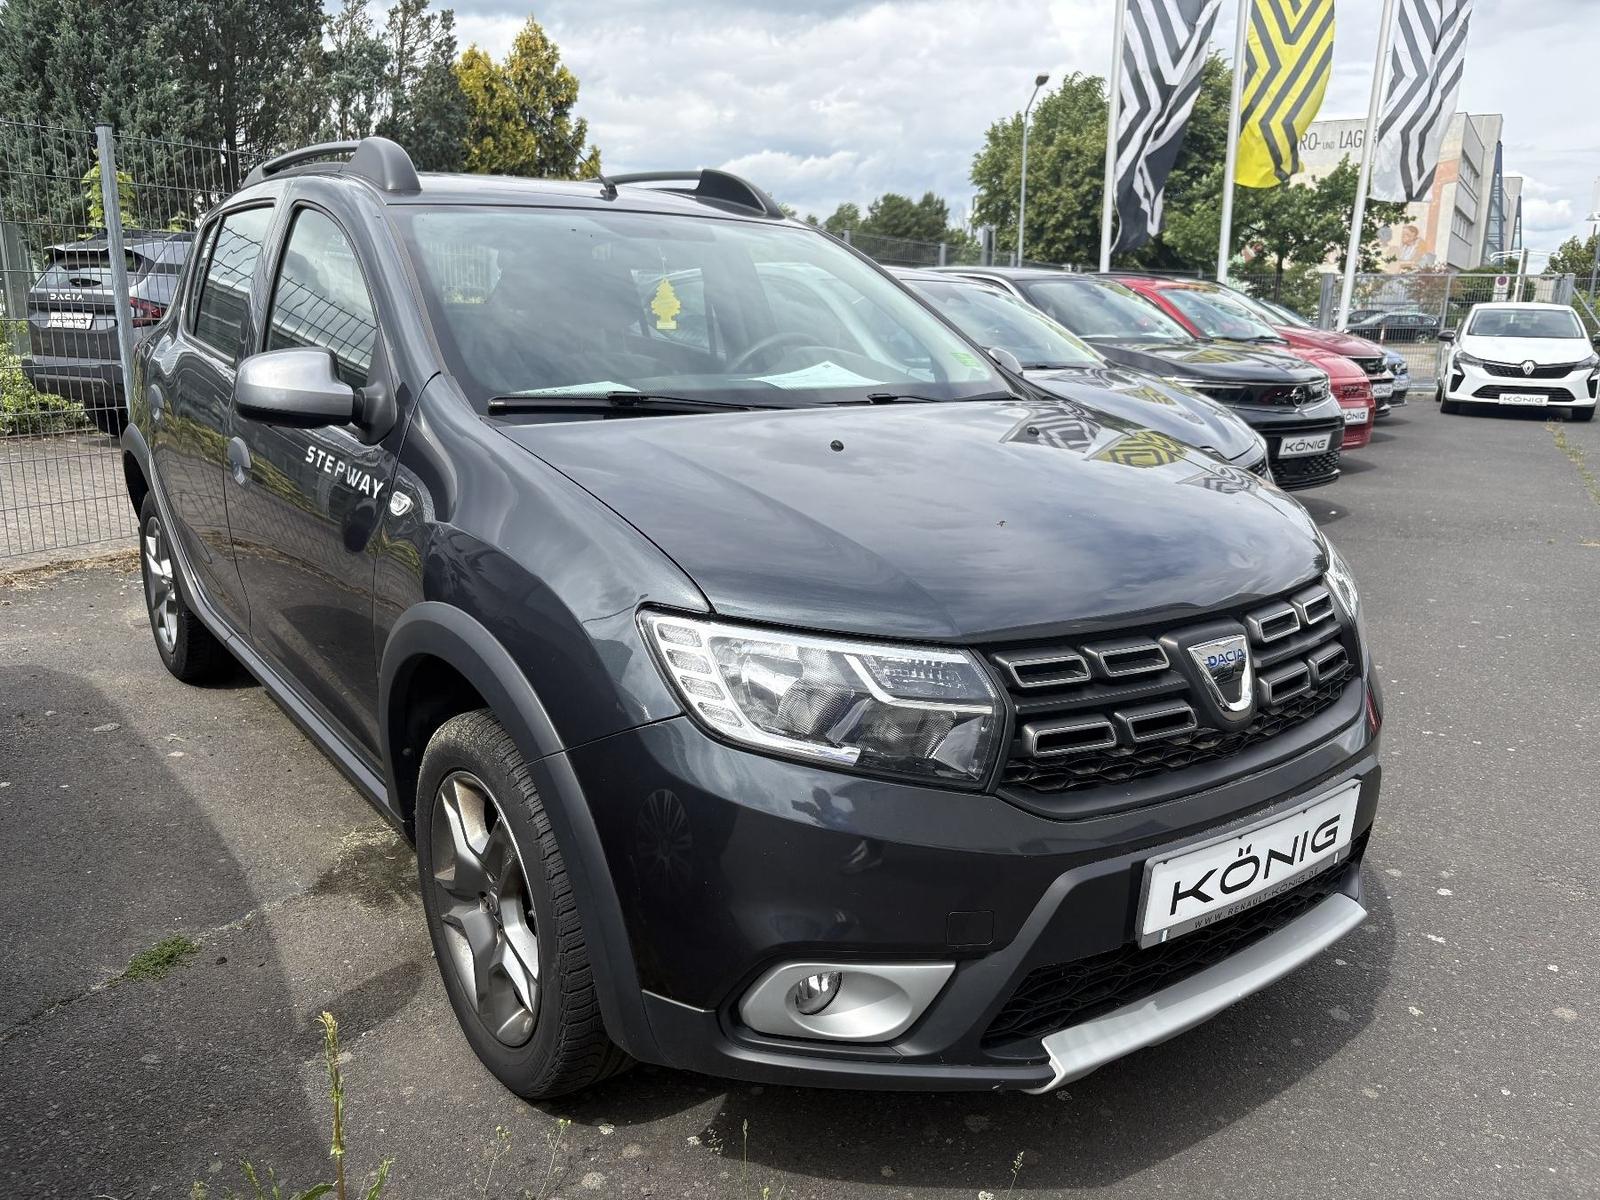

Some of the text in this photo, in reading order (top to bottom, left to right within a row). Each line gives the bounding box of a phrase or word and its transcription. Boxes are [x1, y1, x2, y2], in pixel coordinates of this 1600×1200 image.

[1299, 133, 1321, 151] RO-
[50, 293, 85, 301] DACIA
[1344, 410, 1366, 421] ÖNIG
[1283, 438, 1327, 452] KÖNIG
[305, 445, 384, 499] STEPWAY
[1207, 648, 1246, 668] DACIA
[1169, 813, 1341, 916] KÖNIG
